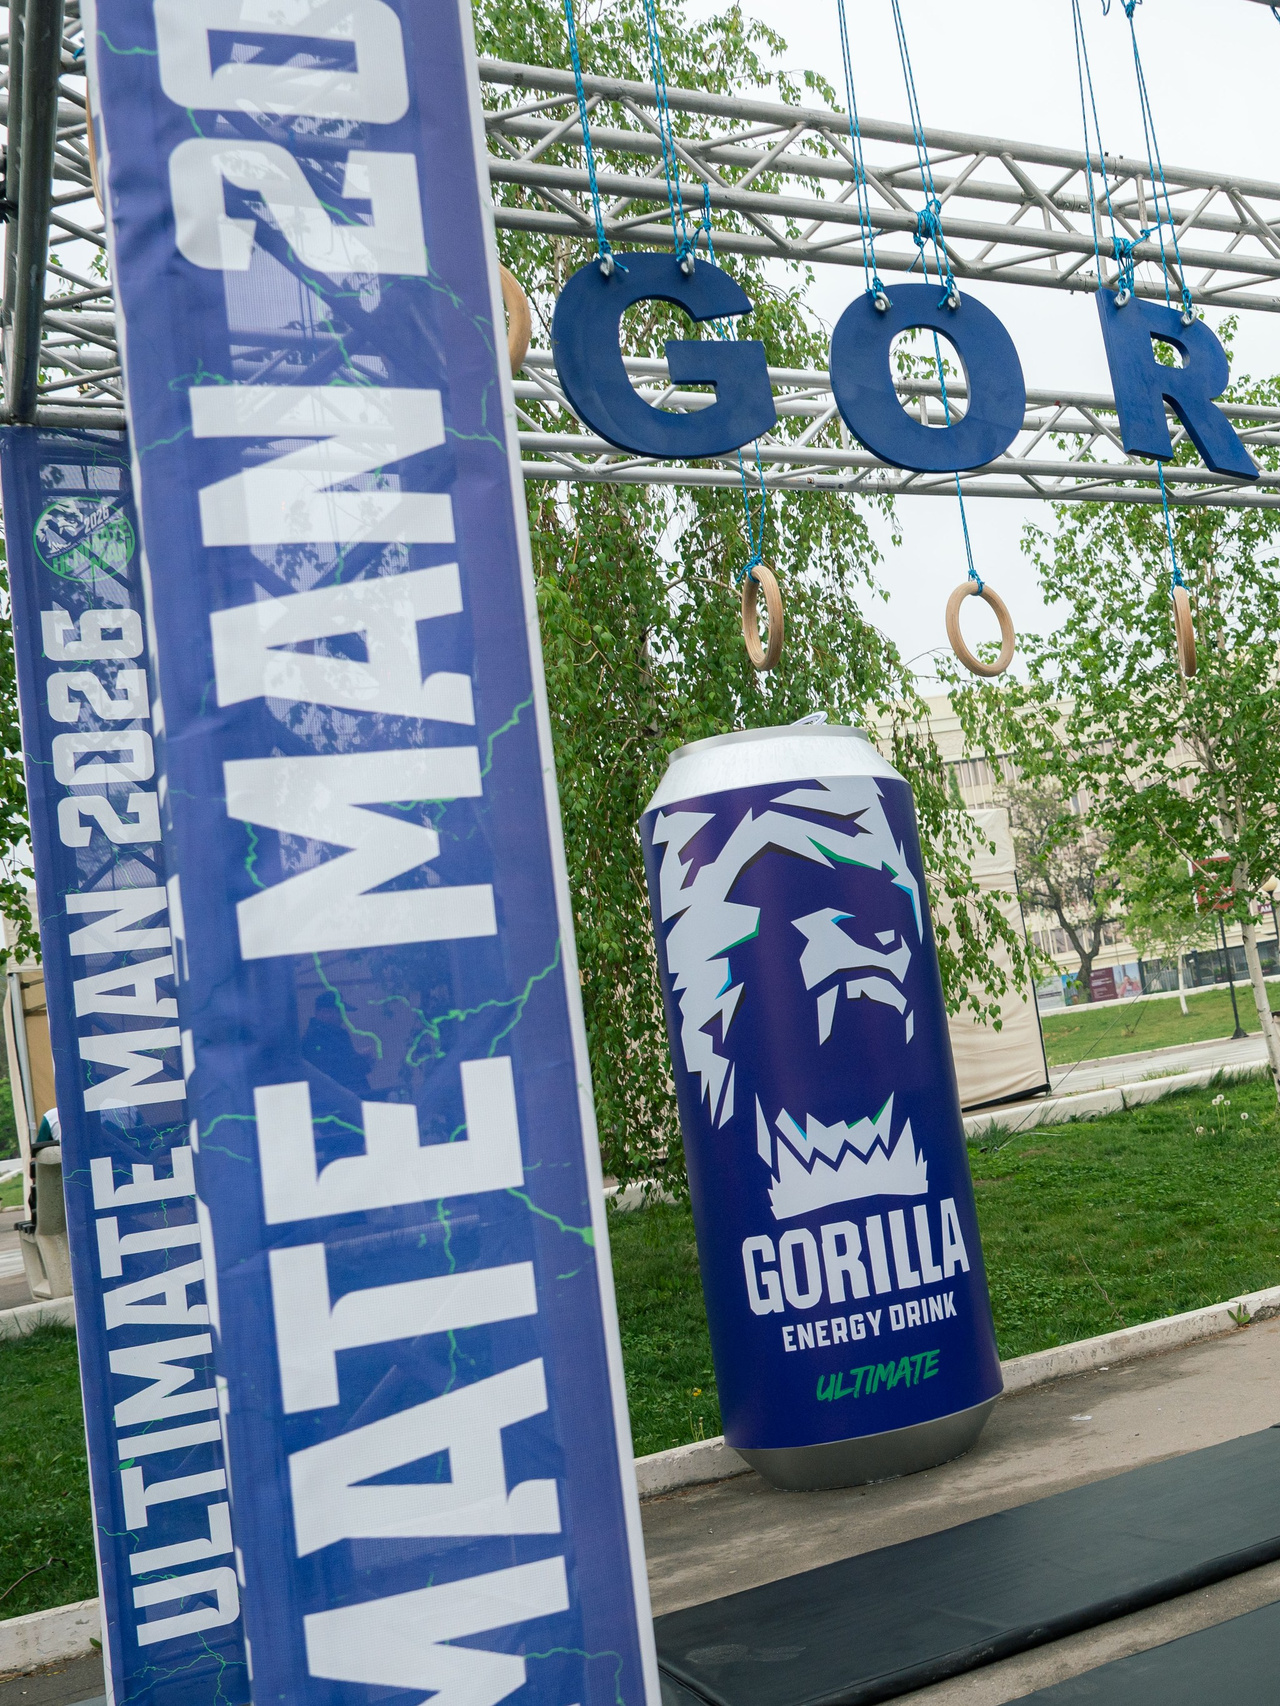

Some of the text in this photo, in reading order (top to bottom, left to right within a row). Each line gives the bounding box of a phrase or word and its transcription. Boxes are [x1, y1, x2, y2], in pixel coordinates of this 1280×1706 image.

[40, 609, 162, 848] 2026
[189, 385, 497, 959] MAN
[65, 886, 188, 1114] MAN
[742, 1197, 970, 1316] GORILLA
[782, 1291, 957, 1352] ENERGY DRINK
[90, 1145, 240, 1647] ULTIMATE
[816, 1349, 941, 1402] ULTIMATE
